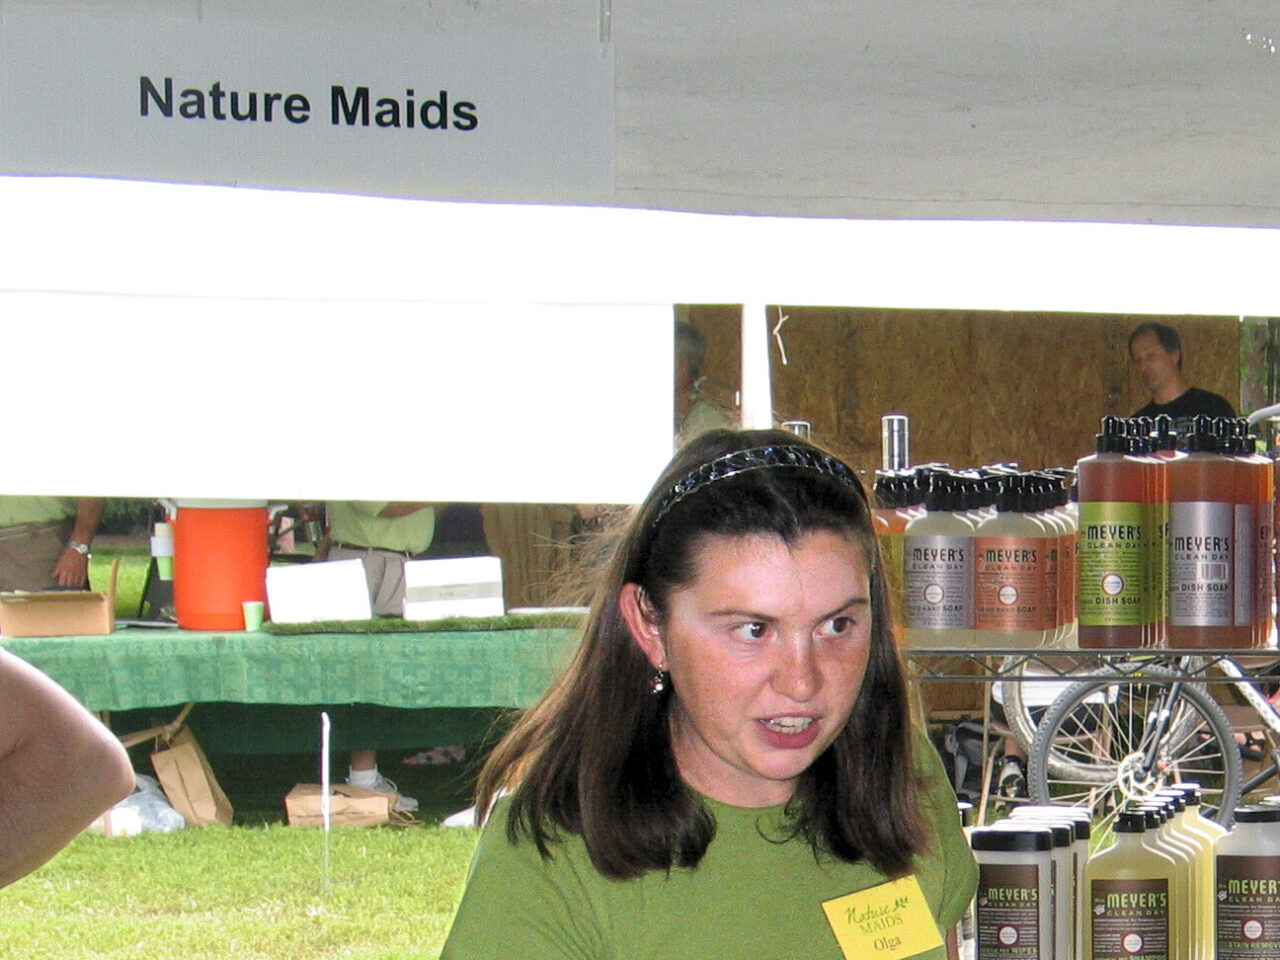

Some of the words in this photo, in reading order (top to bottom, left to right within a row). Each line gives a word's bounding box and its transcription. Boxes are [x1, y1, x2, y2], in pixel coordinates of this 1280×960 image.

[139, 76, 312, 124] Nature
[330, 84, 479, 131] Maids
[1087, 525, 1142, 540] MEYER'S
[1174, 536, 1230, 551] MEYER'S
[912, 548, 964, 563] MEYER'S
[985, 549, 1037, 563] MEYER'S
[1181, 583, 1204, 592] DISH
[1206, 583, 1230, 592] SOAP
[1095, 597, 1118, 605] DISH
[988, 888, 1038, 901] MEYER'S
[1107, 892, 1167, 908] MEYER'S
[1106, 909, 1143, 917] CLEAN
[859, 914, 904, 935] MAIDS
[873, 935, 902, 951] Olga
